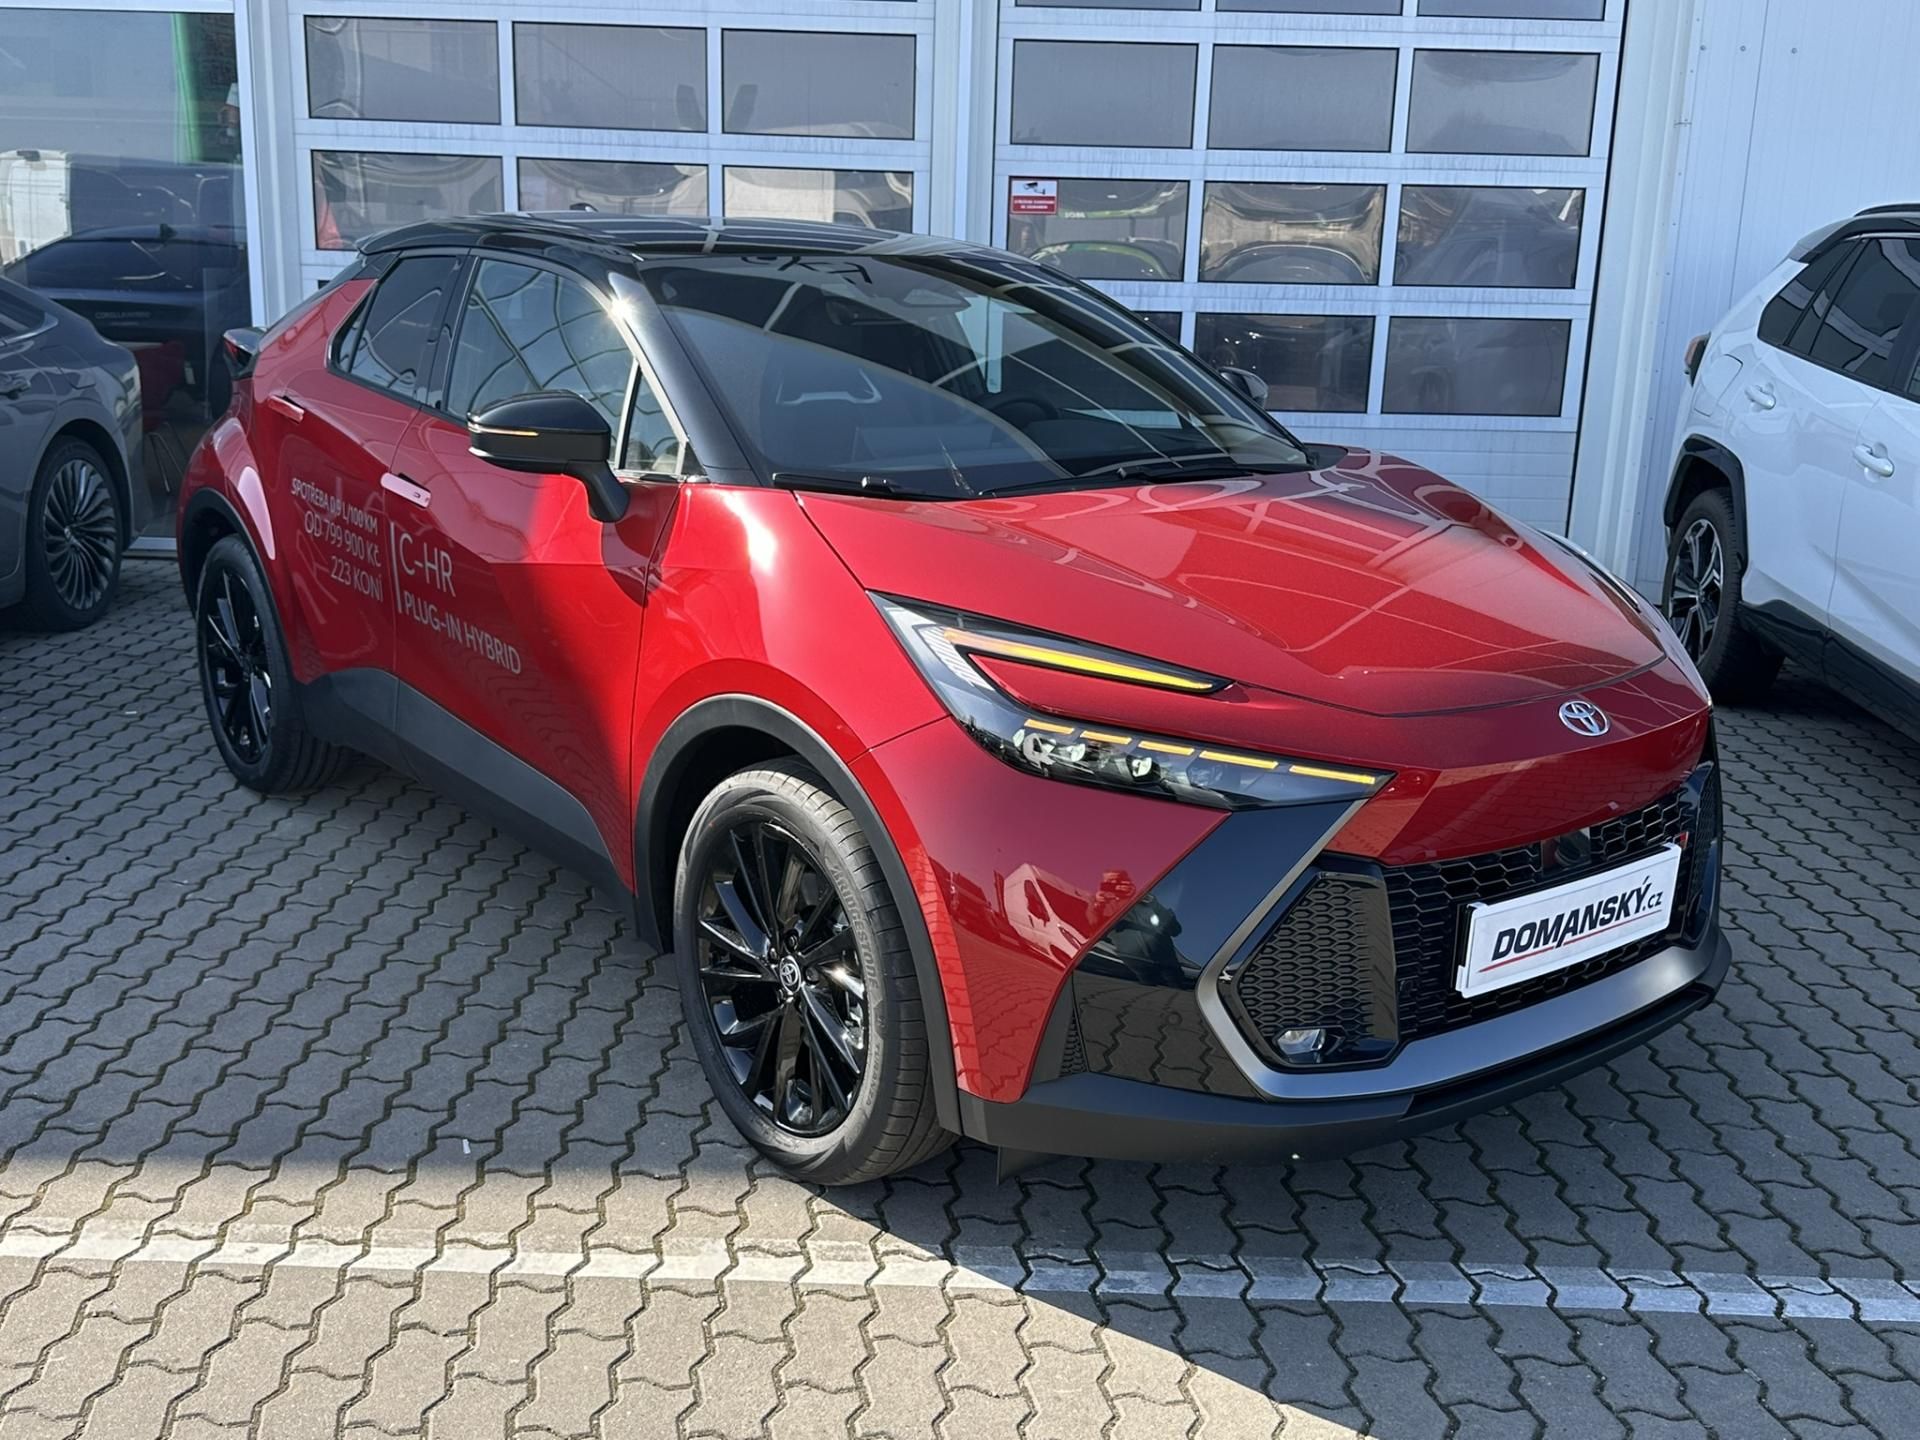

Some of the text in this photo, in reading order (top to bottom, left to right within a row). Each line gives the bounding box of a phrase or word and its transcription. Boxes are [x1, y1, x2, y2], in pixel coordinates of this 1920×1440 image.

[291, 478, 330, 512] SPOTŘEBA
[305, 510, 321, 537] OD
[323, 518, 343, 548] 799
[345, 529, 365, 560] 900
[331, 555, 351, 585] 223
[400, 533, 456, 597] C-HR
[404, 591, 521, 674] PLUG-IN HYBRID
[829, 864, 880, 990] BRIDGESTONE
